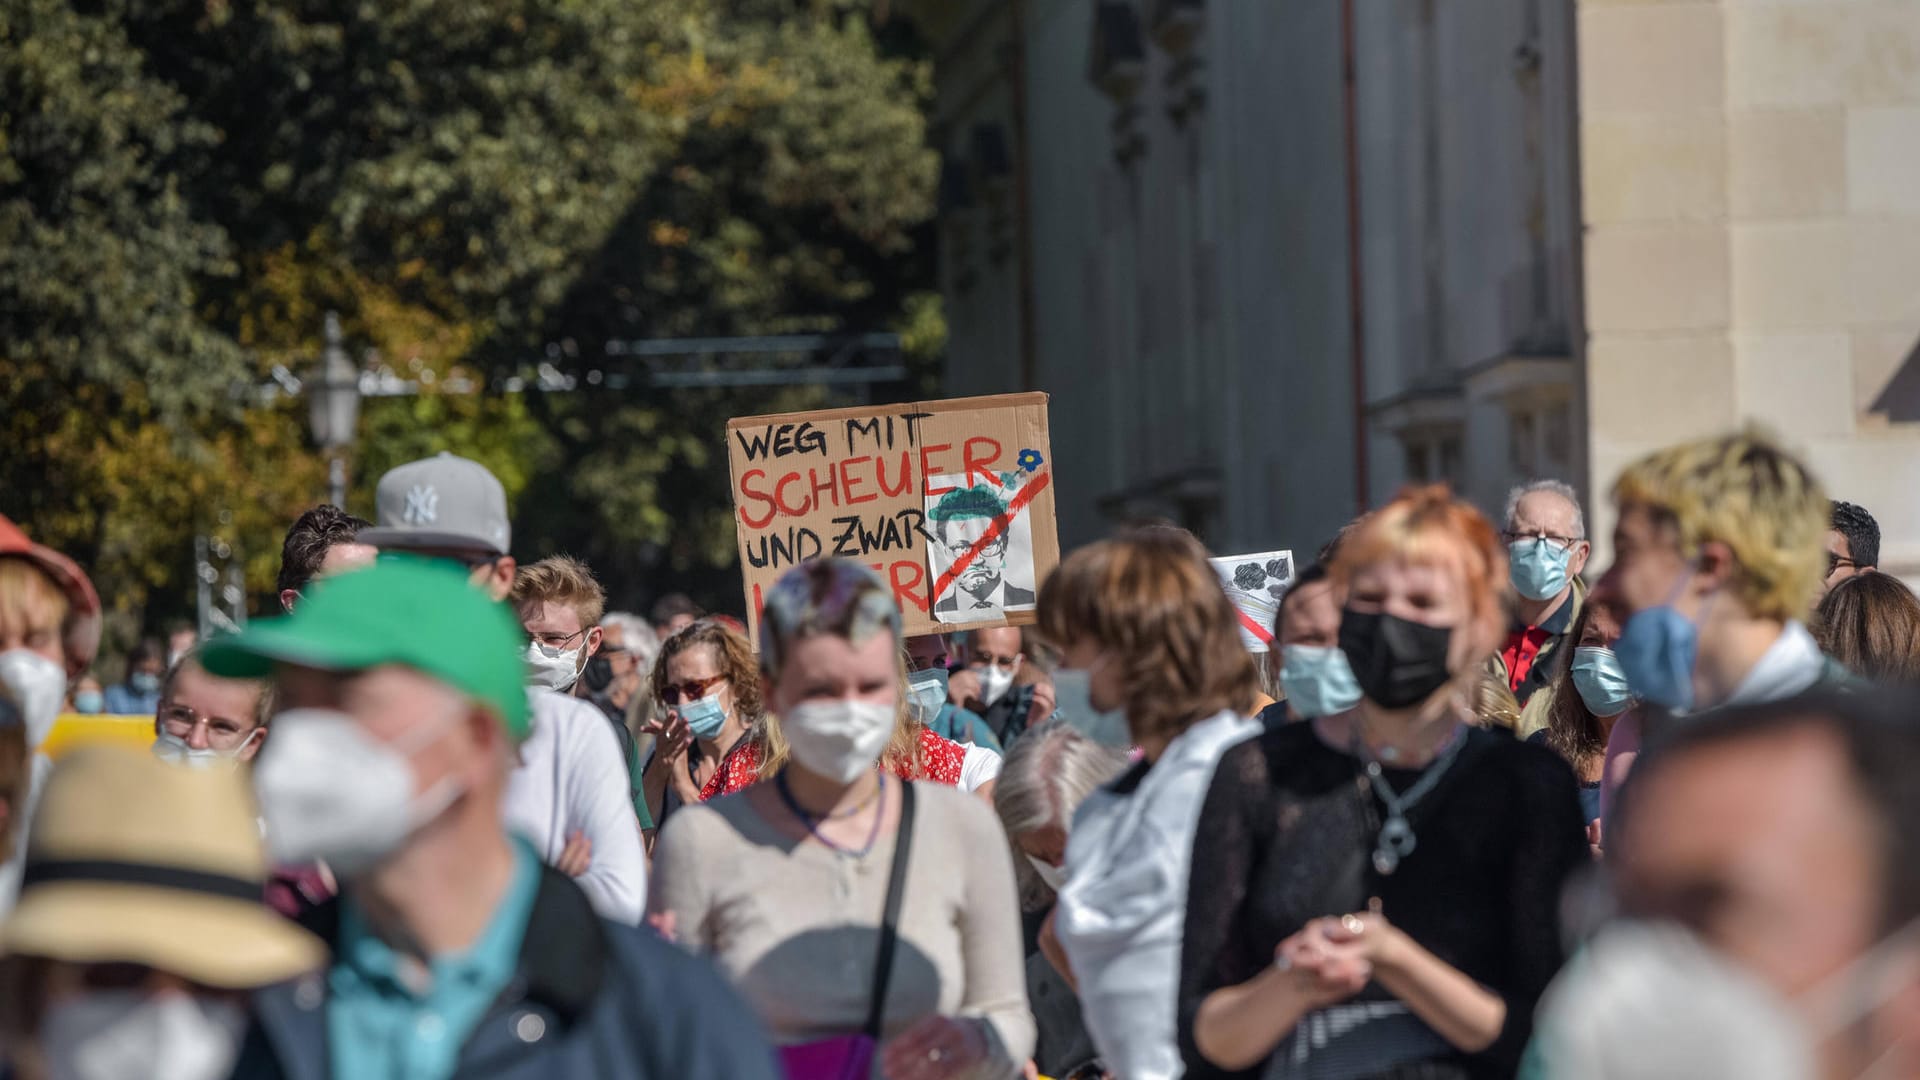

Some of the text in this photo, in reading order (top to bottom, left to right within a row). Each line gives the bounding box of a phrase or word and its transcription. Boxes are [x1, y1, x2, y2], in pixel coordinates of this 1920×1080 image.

[737, 413, 934, 462] WEG MIT
[404, 485, 438, 523] NY
[739, 436, 1004, 529] SCHEUER
[747, 509, 936, 568] UND ZWAR
